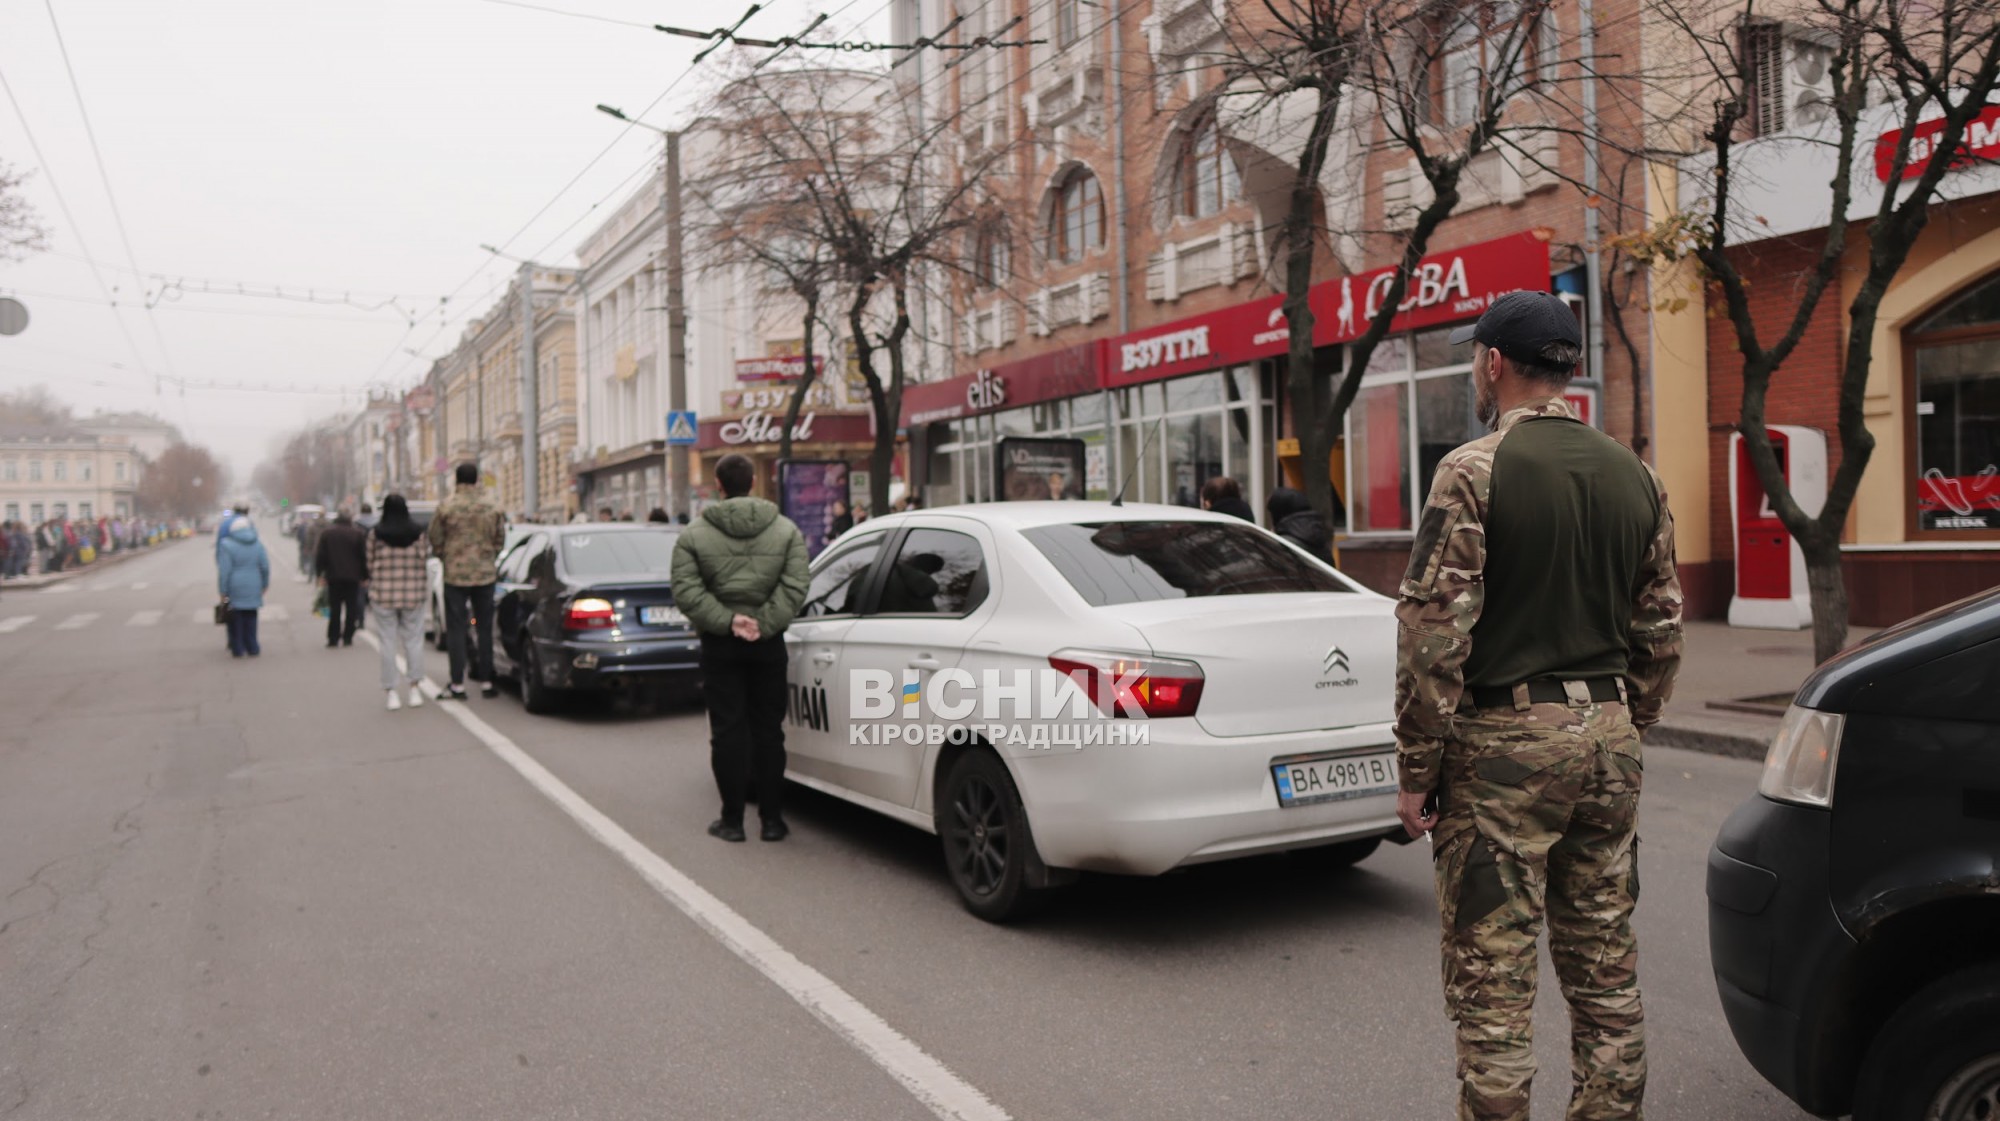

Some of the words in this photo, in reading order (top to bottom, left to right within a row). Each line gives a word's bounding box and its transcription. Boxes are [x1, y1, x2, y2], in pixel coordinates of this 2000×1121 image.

[1121, 325, 1210, 372] ВЗУТТЯ
[967, 369, 1005, 409] elis
[1292, 767, 1323, 792] BA
[1326, 761, 1369, 788] 4981
